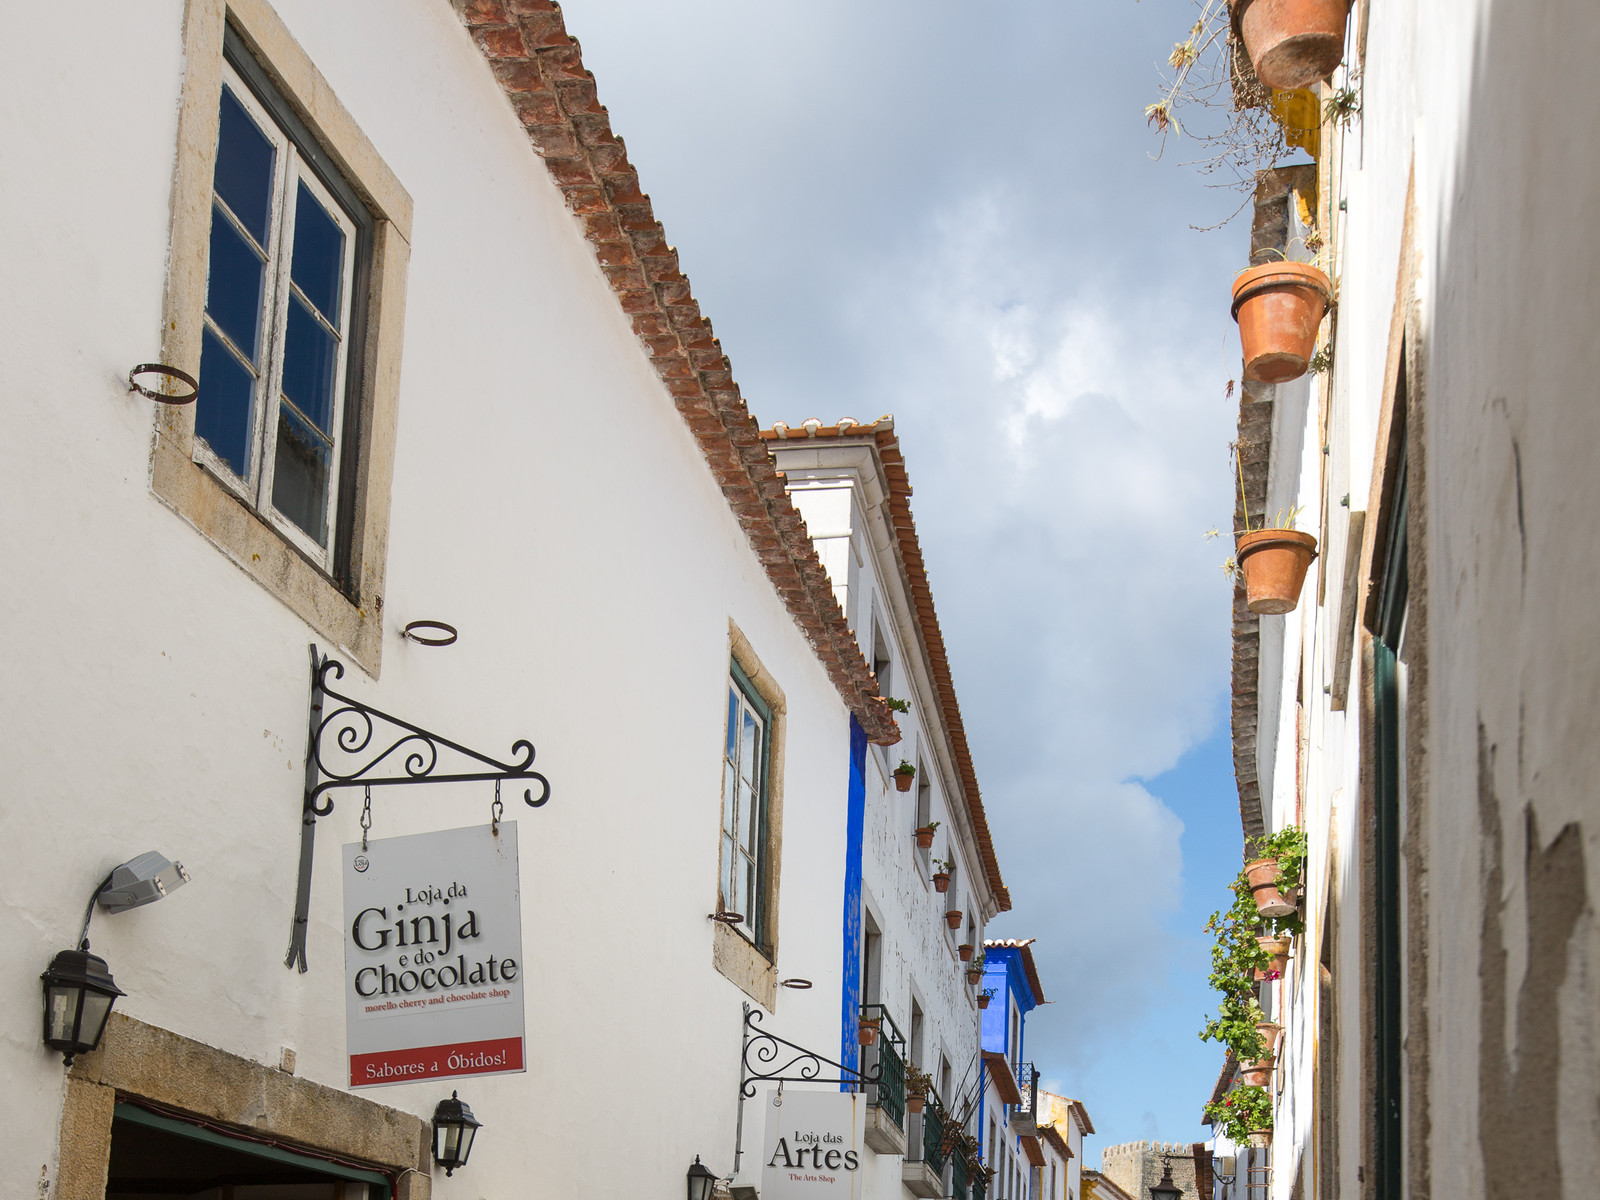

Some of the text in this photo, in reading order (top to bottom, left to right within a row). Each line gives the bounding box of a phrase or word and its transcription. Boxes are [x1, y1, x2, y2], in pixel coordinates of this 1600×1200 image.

[405, 881, 467, 906] Loja da
[352, 898, 480, 955] Ginja
[399, 949, 435, 966] e do
[355, 954, 517, 997] Chocolate
[364, 988, 510, 1013] morello cherry and chocolate shop
[366, 1050, 507, 1079] Sabores a Óbidos!
[794, 1131, 843, 1144] Loja das
[767, 1137, 859, 1170] Artes
[789, 1173, 836, 1184] The Arts Shop
